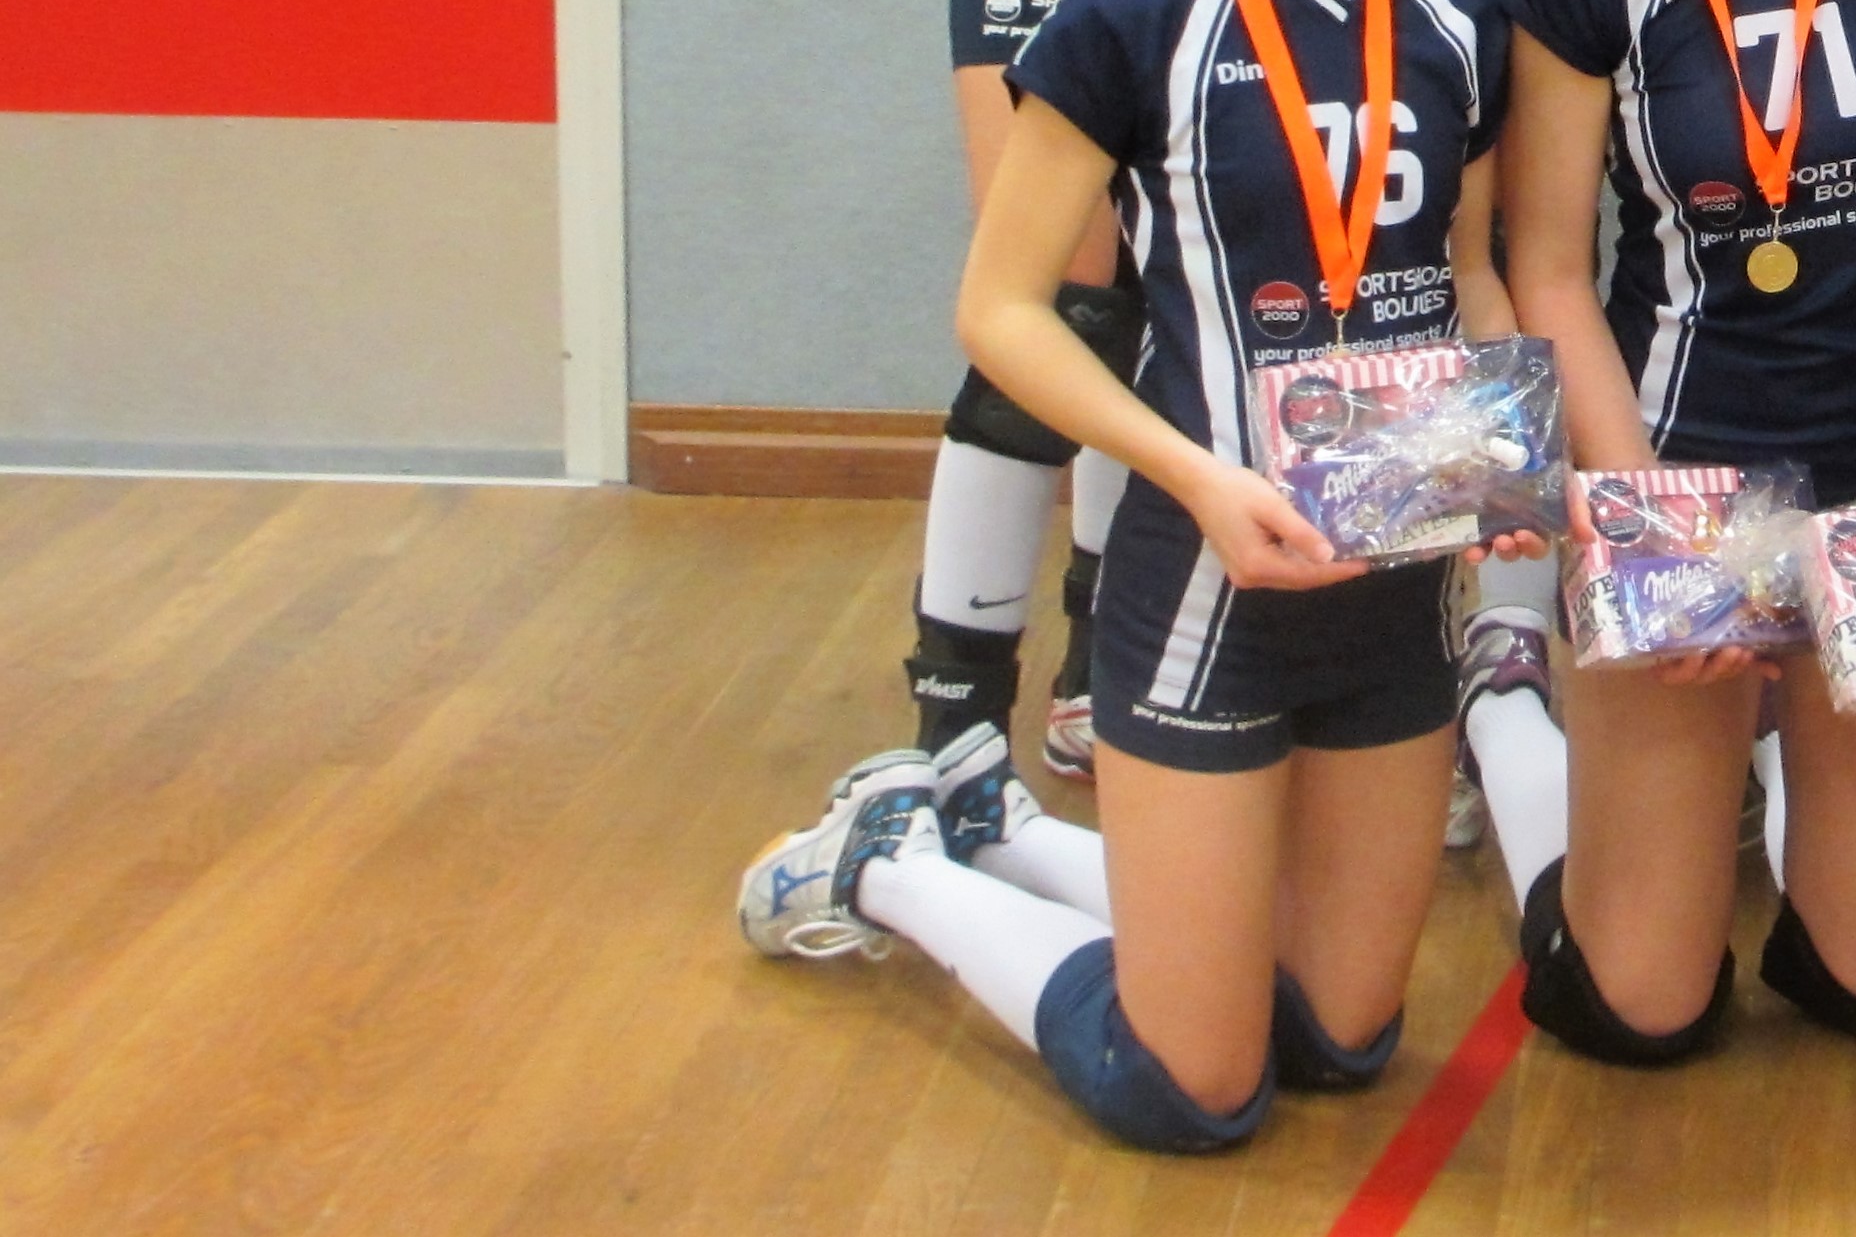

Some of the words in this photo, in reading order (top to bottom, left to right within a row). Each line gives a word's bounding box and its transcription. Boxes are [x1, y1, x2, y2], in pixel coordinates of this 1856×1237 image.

[1304, 100, 1424, 226] 76
[1694, 192, 1738, 206] SPORT
[1700, 230, 1734, 247] your
[1257, 298, 1302, 310] SPORT
[1262, 310, 1300, 321] 2000
[1254, 348, 1293, 366] your
[1643, 562, 1712, 602] Milka
